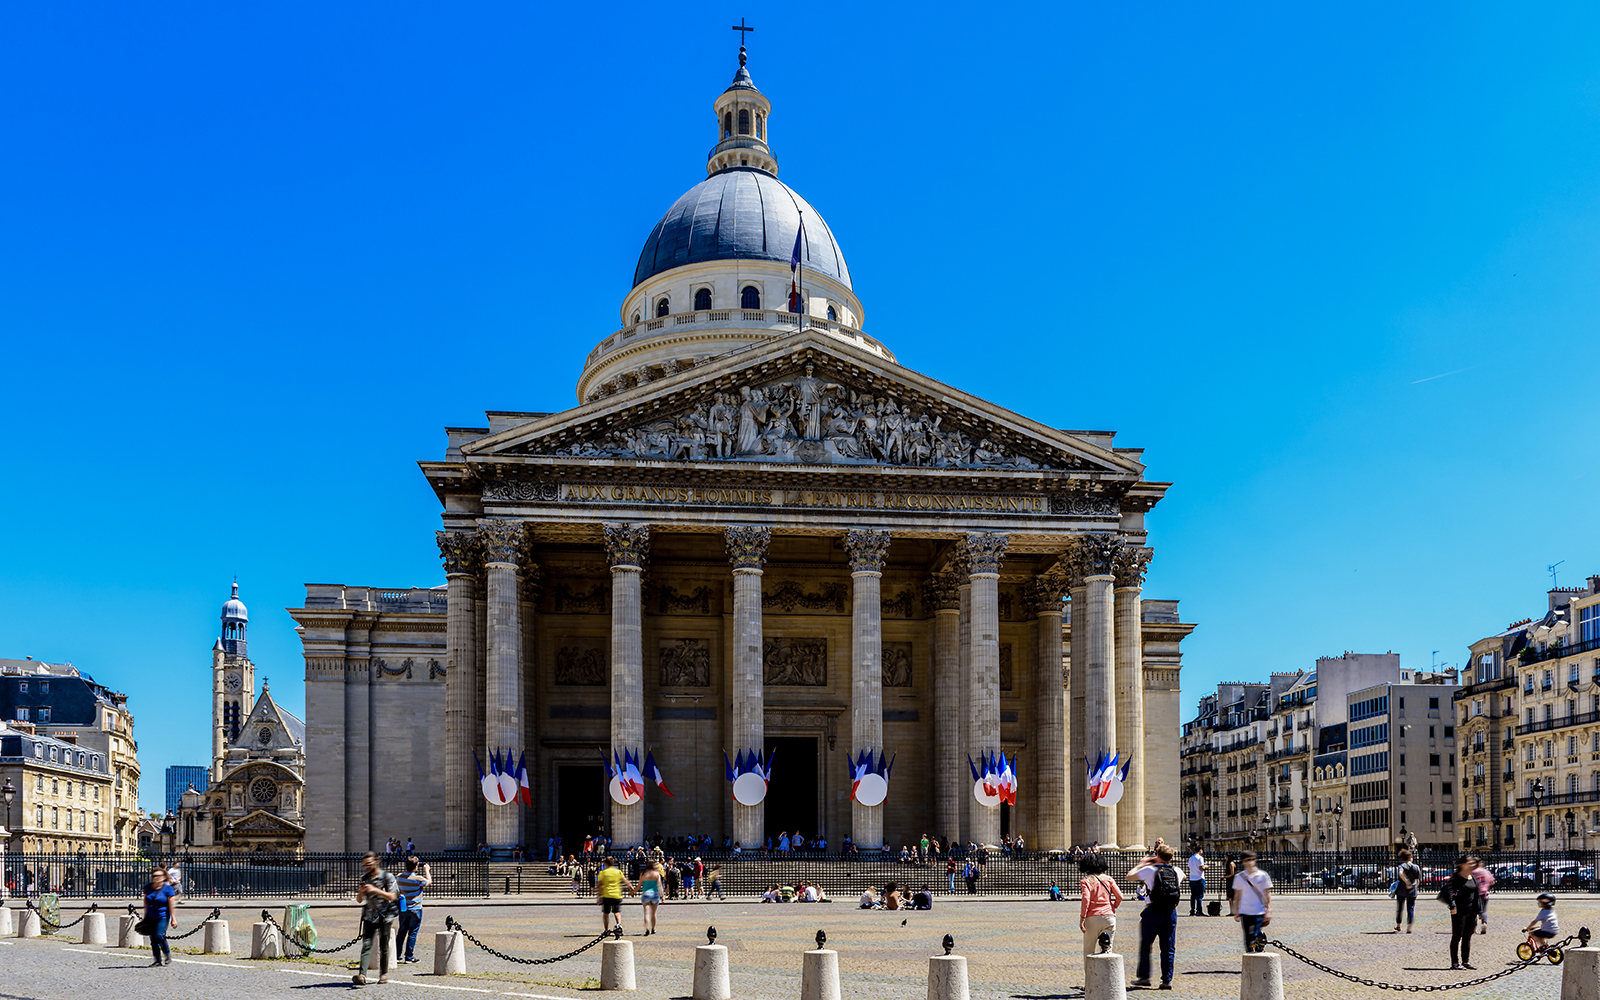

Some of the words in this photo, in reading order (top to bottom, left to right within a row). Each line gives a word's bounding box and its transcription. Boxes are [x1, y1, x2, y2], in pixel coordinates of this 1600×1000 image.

[565, 485, 606, 500] AUX
[611, 486, 689, 502] GRANDS
[692, 488, 773, 504] HOMMES
[783, 491, 807, 505] LA
[811, 492, 878, 507] PATRIE
[883, 493, 1043, 511] RECONNAISSANTE
